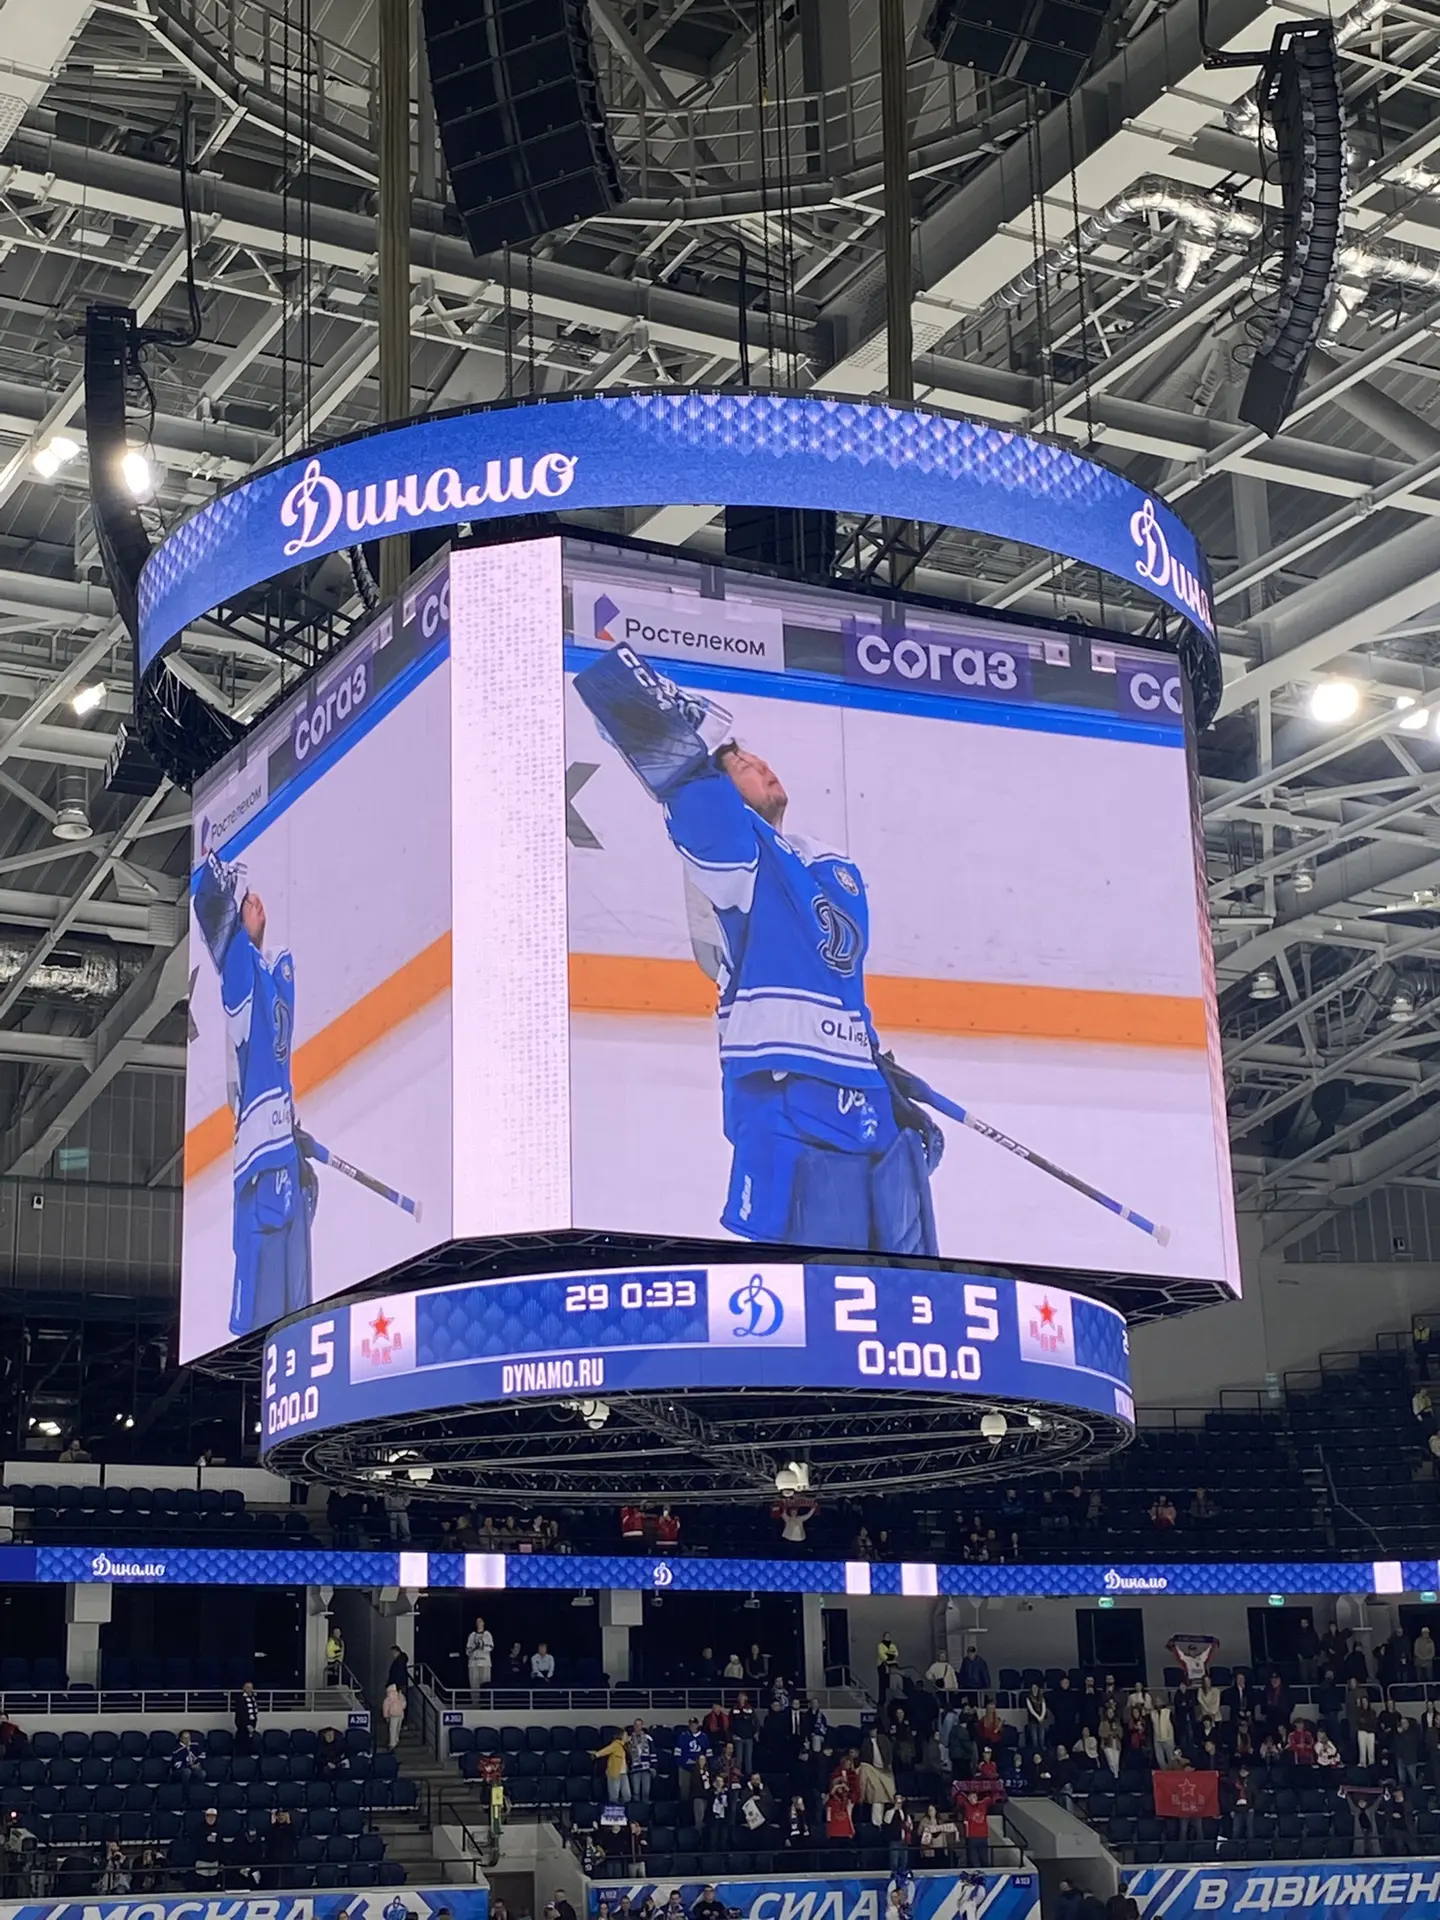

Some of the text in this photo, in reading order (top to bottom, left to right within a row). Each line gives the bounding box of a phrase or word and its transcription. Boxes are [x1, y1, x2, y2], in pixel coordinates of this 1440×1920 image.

[280, 452, 578, 556] Динамо
[624, 618, 766, 657] Ростелеком
[210, 785, 262, 842] Ростелеком
[565, 1280, 696, 1312] 29 0:33
[834, 1275, 999, 1341] 2 3 5
[266, 1320, 335, 1399] 2 3 5
[502, 1358, 604, 1394] DYNAMO.RU
[858, 1339, 981, 1381] 0:00.0
[268, 1386, 319, 1436] 0:00.0
[92, 1552, 166, 1577] Динамо
[1104, 1568, 1168, 1590] Динамо
[750, 1889, 879, 1920] СИЛА
[1193, 1872, 1440, 1914] В ДВИЖЕН
